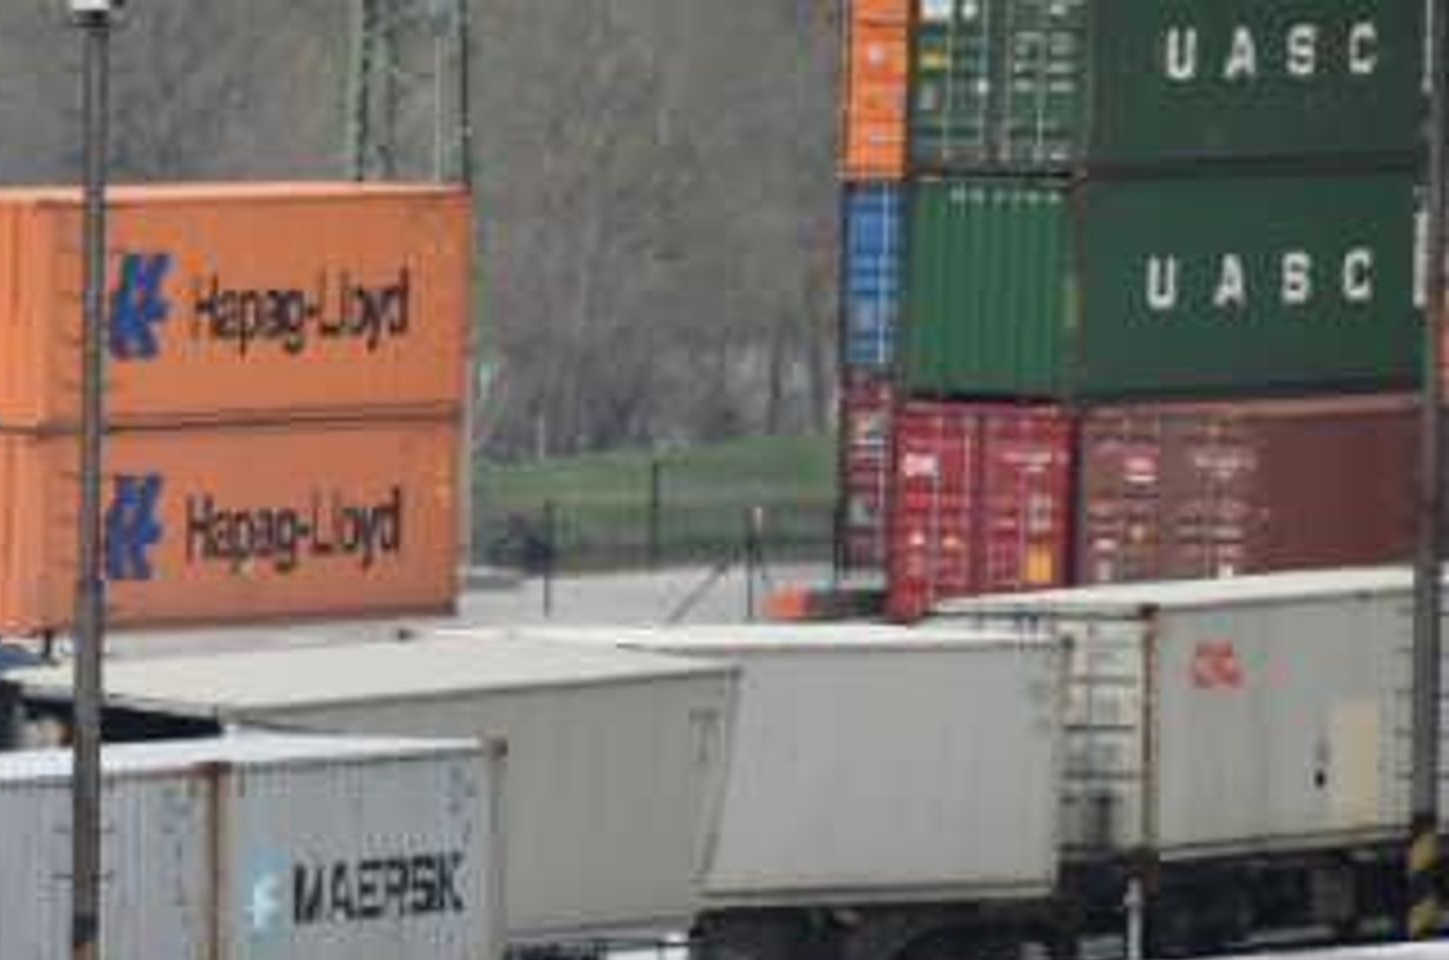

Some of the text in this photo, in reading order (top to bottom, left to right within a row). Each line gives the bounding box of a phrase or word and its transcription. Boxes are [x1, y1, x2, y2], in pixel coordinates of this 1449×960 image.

[1166, 22, 1378, 79] UASC
[193, 266, 409, 357] Hapag-Lloyd
[1146, 248, 1372, 310] UASC
[184, 486, 401, 574] Hapag-Lloyd
[294, 852, 464, 923] MAERSK
